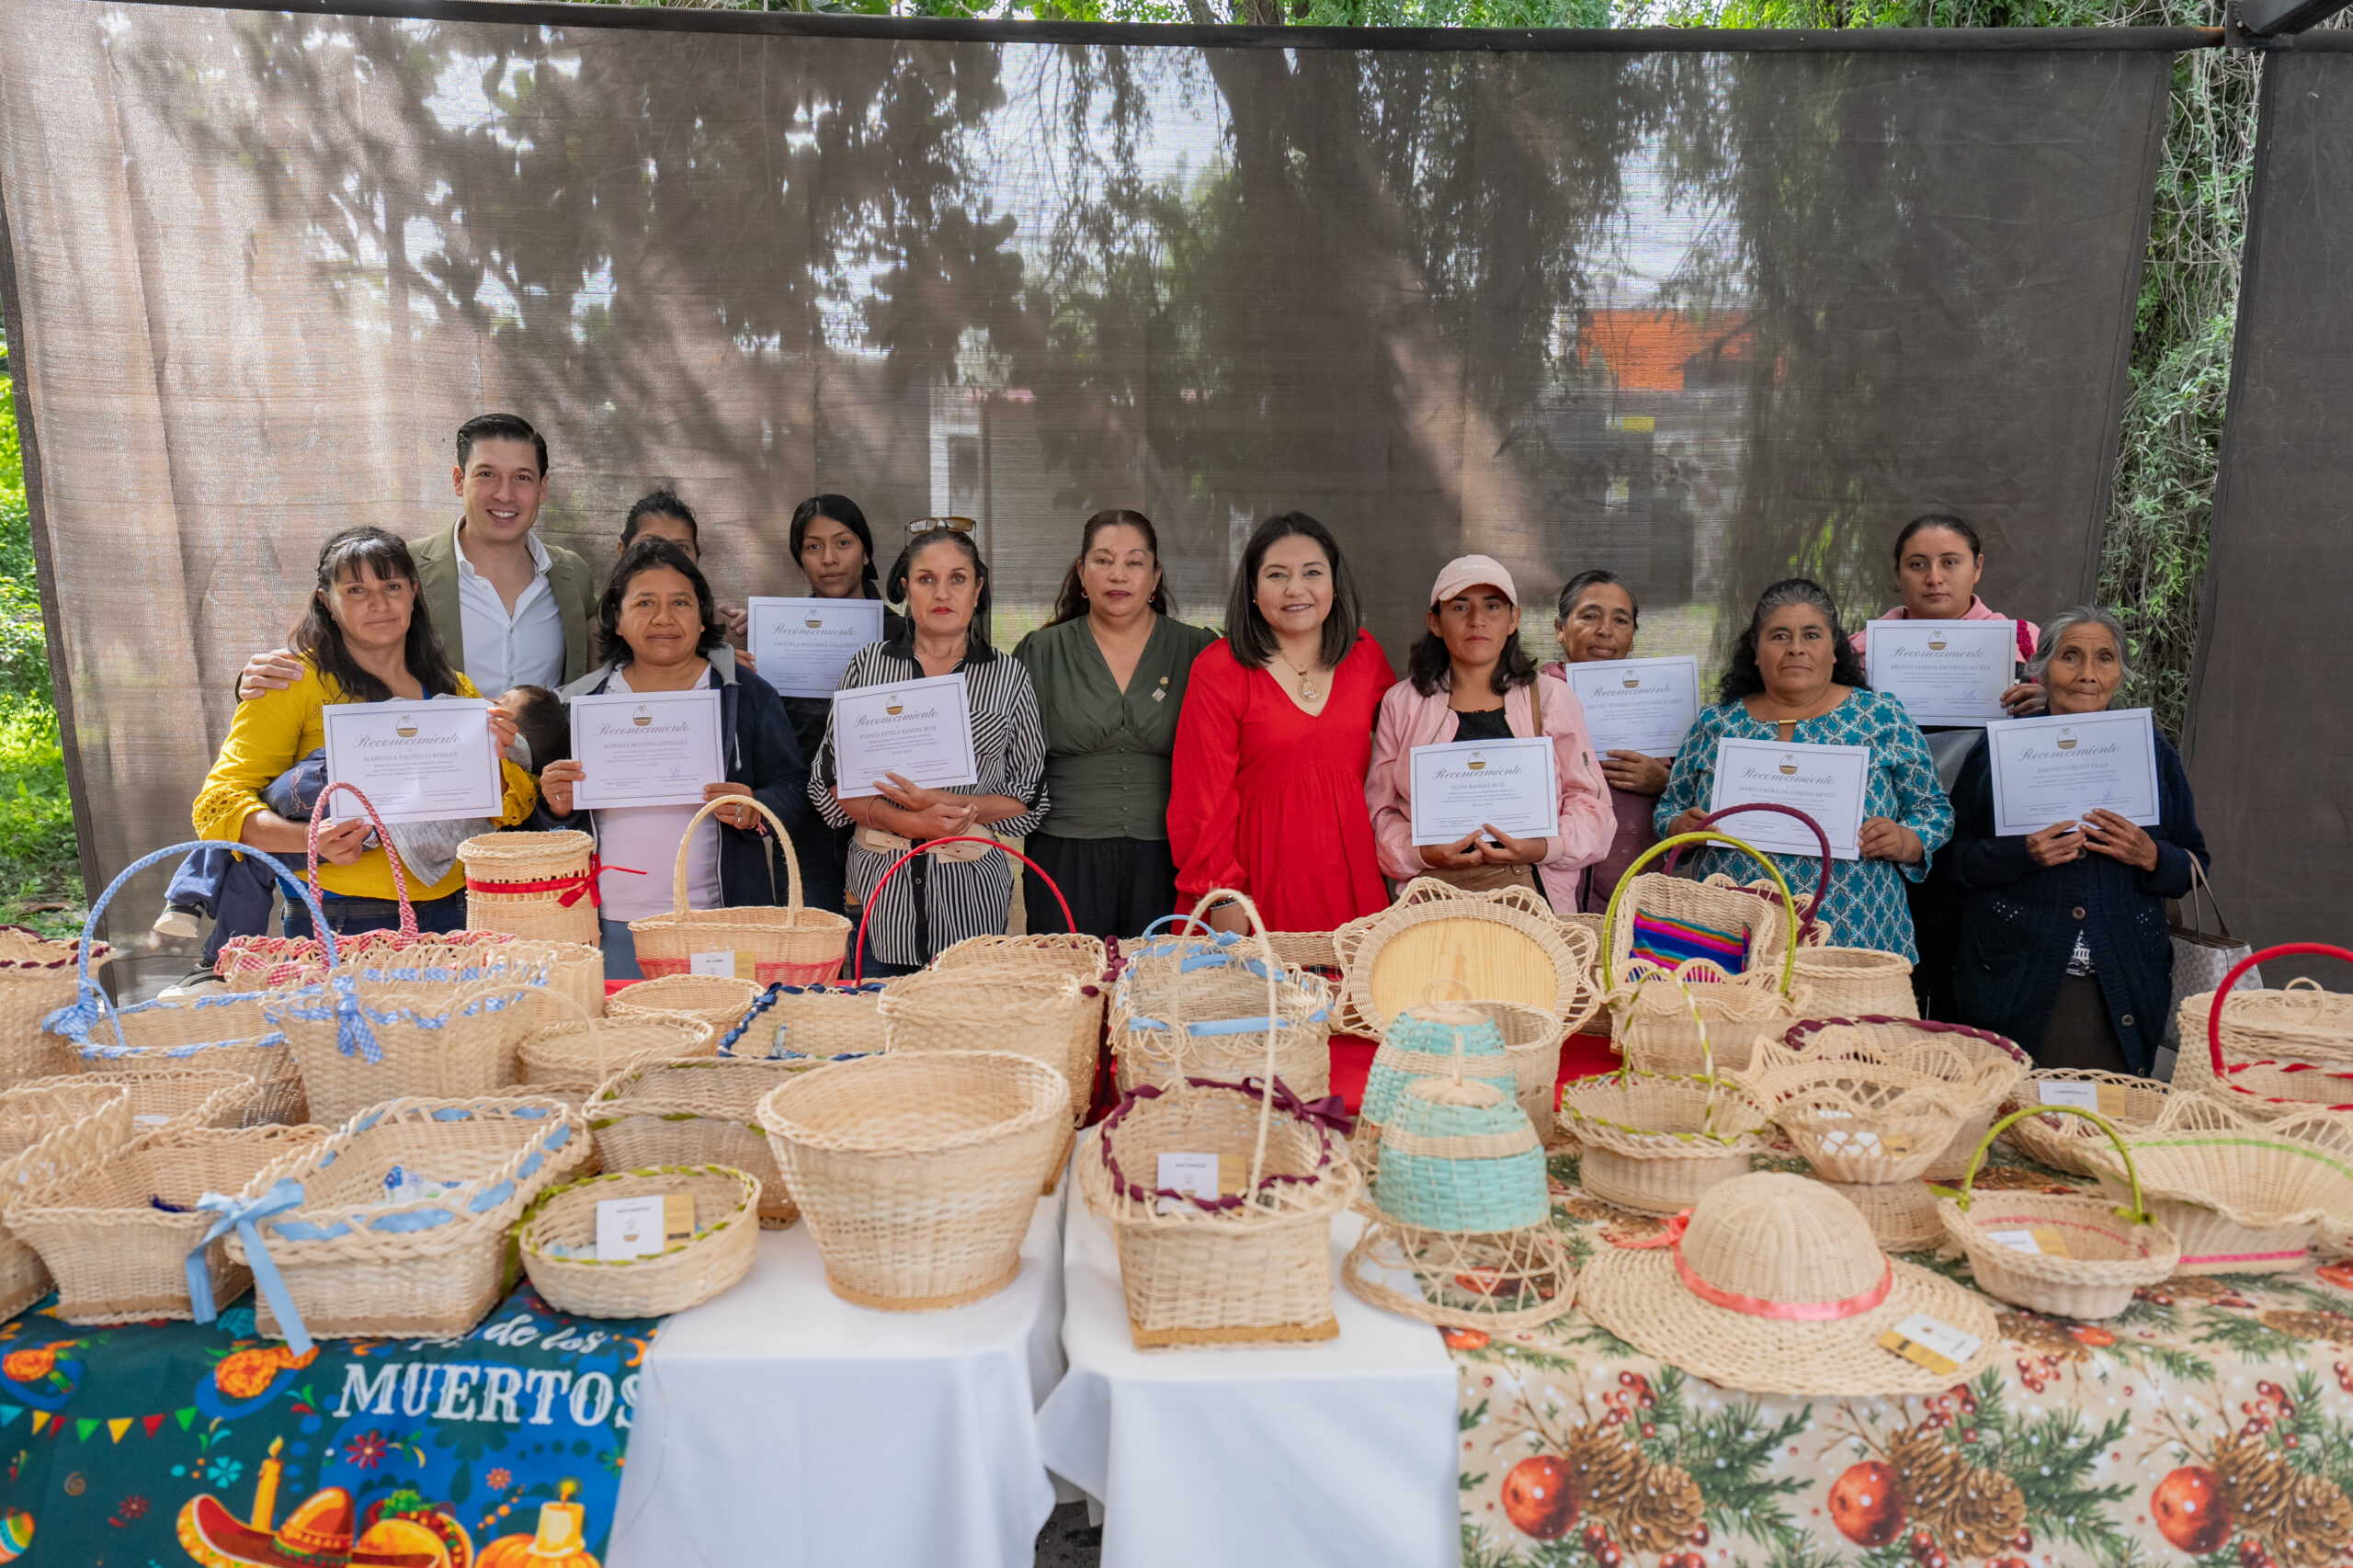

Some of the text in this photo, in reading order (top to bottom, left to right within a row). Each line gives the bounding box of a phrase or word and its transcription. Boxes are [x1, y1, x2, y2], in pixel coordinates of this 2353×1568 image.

[770, 623, 856, 636] Reconocimiento
[1890, 645, 1984, 658] Reconocimiento
[1589, 683, 1673, 698] Reconocimiento
[853, 707, 938, 728] Reconocimiento
[596, 721, 690, 735] Reconocimiento
[353, 732, 461, 749] Reconocimiento
[2018, 743, 2119, 761] Reconocimiento
[1432, 765, 1522, 779] Reconocimiento
[1740, 766, 1835, 785] Reconocimiento
[483, 1313, 539, 1346] de
[540, 1326, 608, 1354] los
[332, 1362, 642, 1428] MUERTOS
